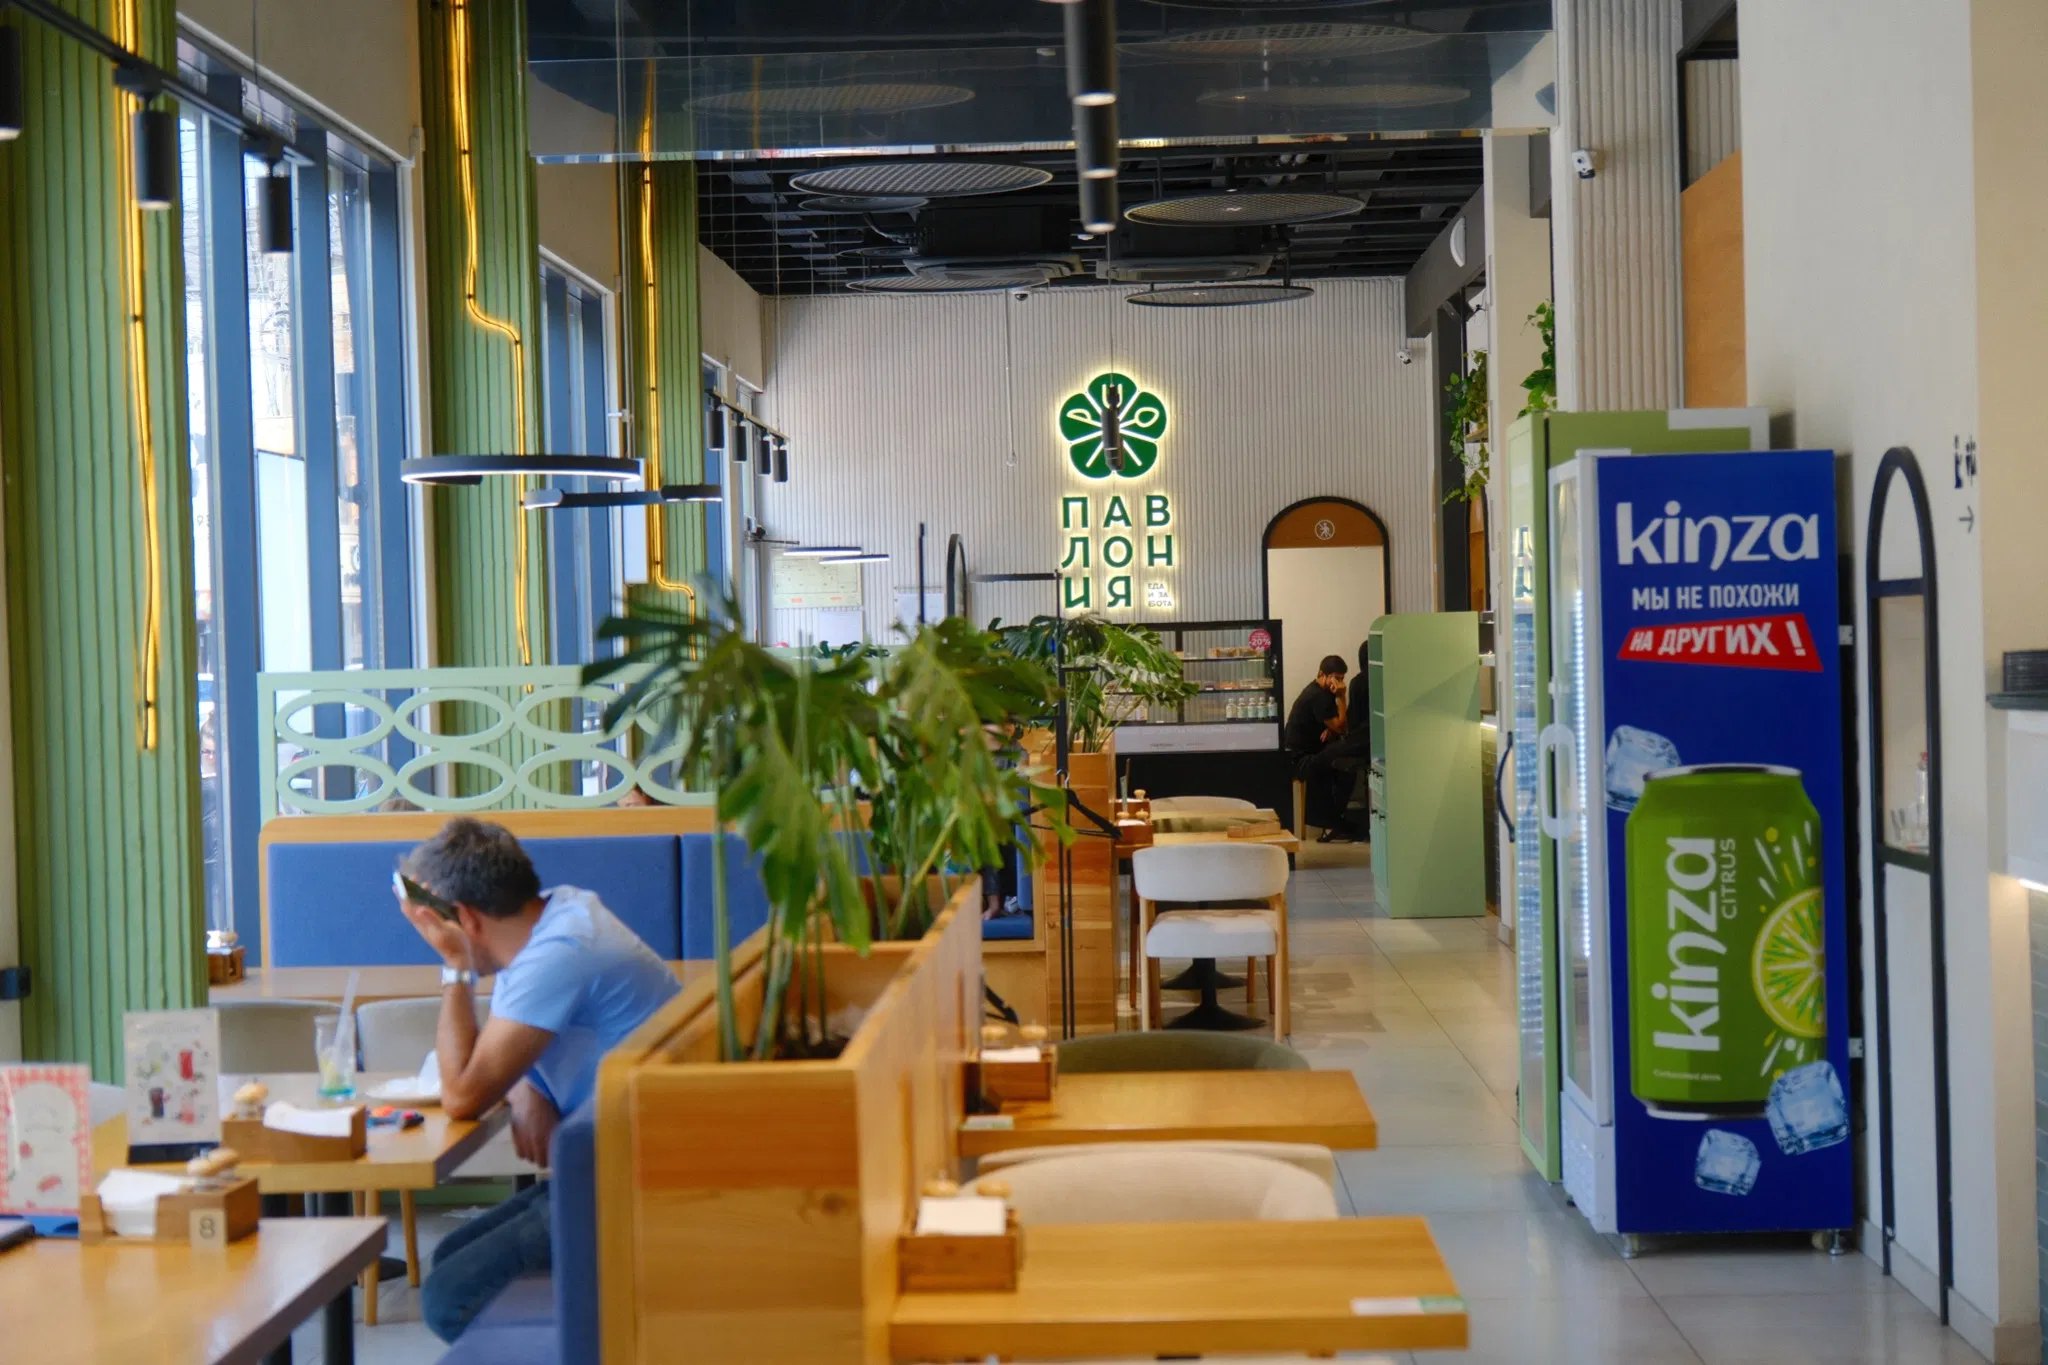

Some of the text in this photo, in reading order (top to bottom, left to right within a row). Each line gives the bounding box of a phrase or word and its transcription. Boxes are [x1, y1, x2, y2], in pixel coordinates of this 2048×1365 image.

[1616, 500, 1820, 571] kinza
[1632, 583, 1799, 610] МЫ НЕ ПОХОЖИ
[1629, 629, 1653, 651] НА
[1720, 837, 1737, 920] CITRUS
[1650, 836, 1728, 1052] kinza
